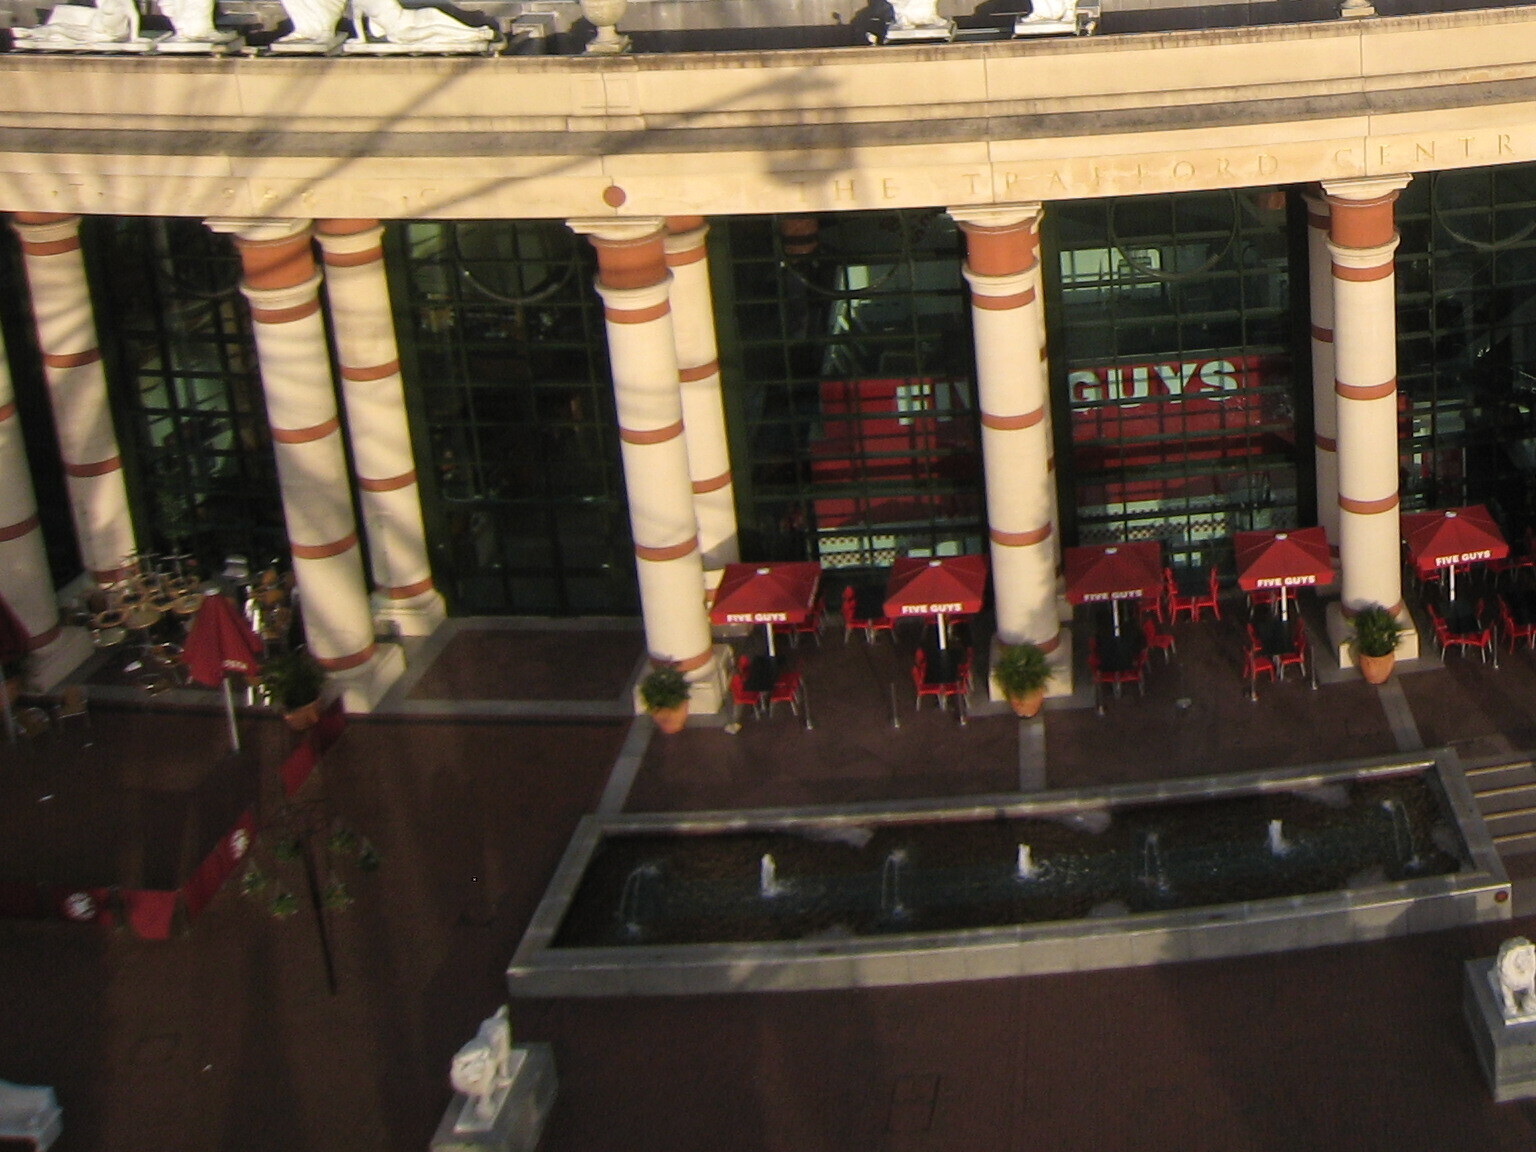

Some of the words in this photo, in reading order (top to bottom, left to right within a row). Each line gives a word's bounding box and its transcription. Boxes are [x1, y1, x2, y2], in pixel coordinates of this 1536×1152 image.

[792, 176, 900, 203] THE
[1068, 359, 1240, 412] GUYS
[1435, 554, 1460, 567] FIVE
[1461, 550, 1492, 563] GUYS
[1256, 577, 1283, 588] FIVE
[1284, 575, 1317, 586] GUYS
[1083, 591, 1109, 602] FIVE
[1111, 589, 1144, 600] GUYS
[901, 604, 929, 615] FIVE
[930, 602, 963, 613] GUYS
[726, 614, 753, 623] FIVE
[754, 612, 788, 623] GUYS
